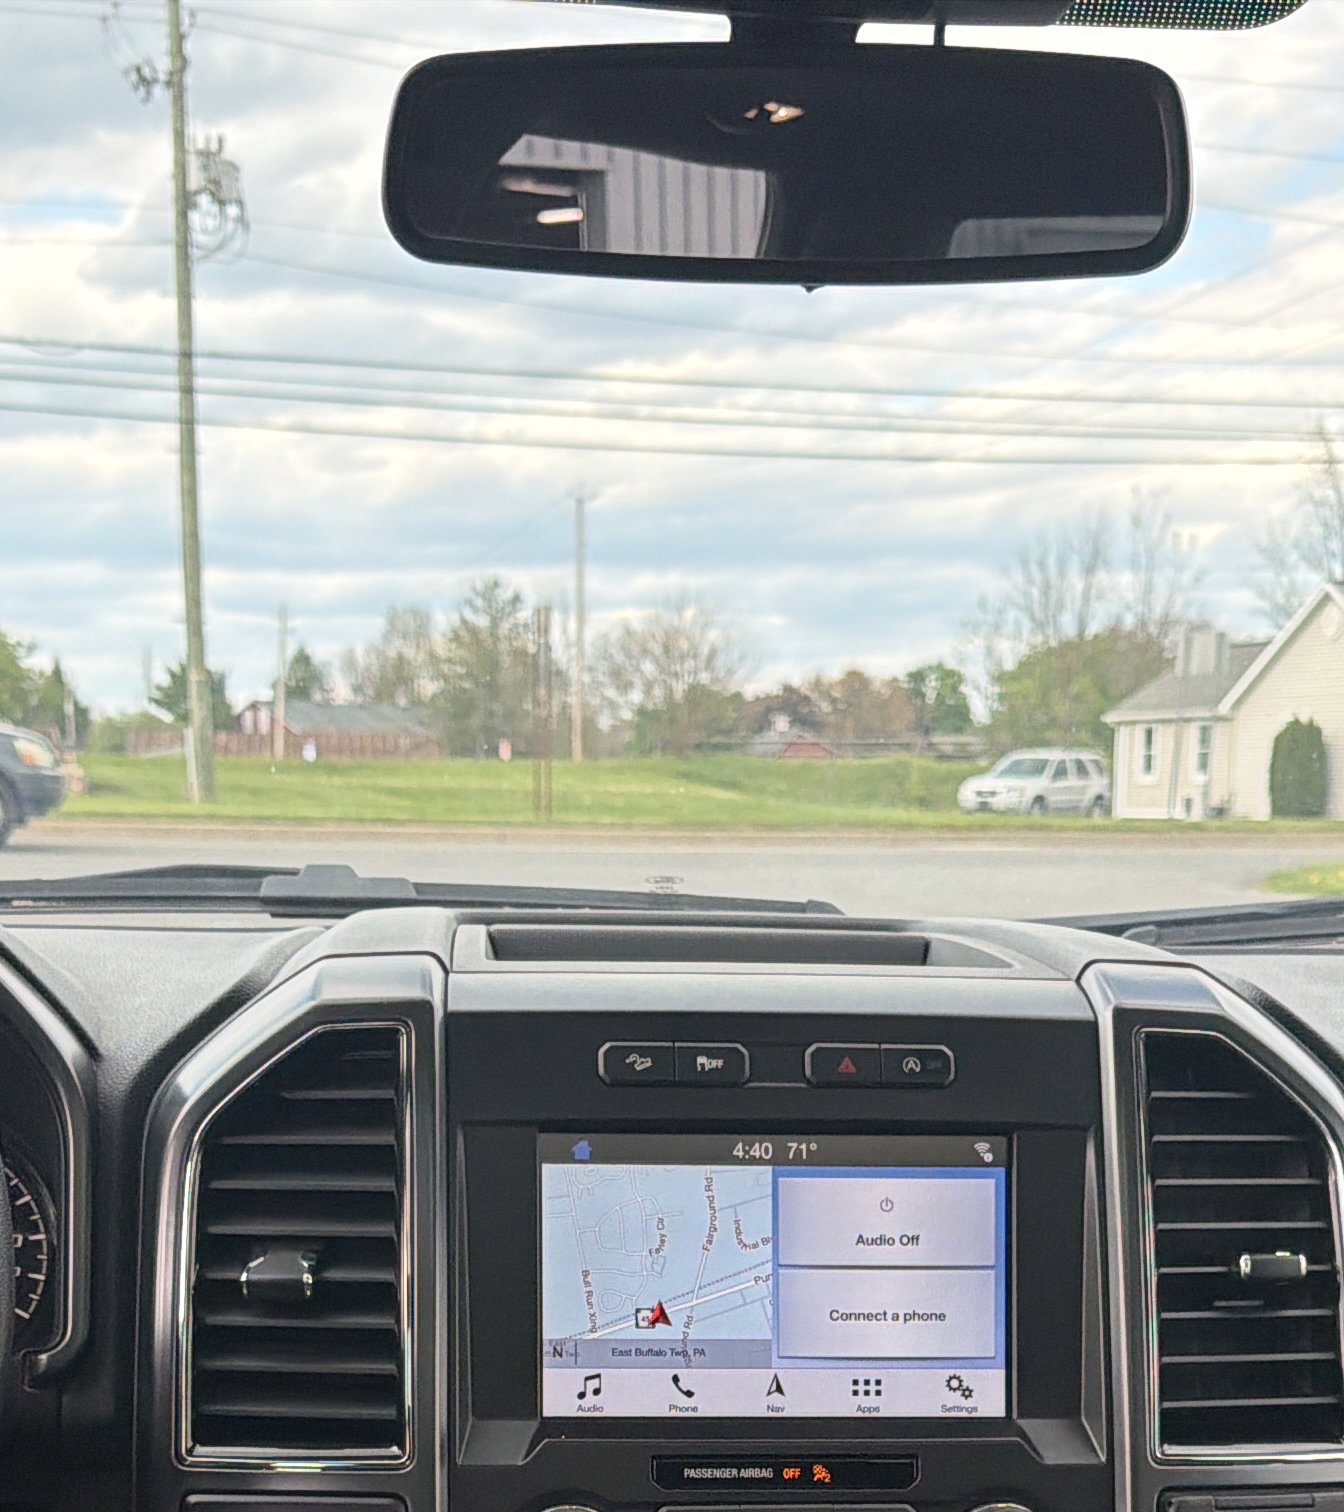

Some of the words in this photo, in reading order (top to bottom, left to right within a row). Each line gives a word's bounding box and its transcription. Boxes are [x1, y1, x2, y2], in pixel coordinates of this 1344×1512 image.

[707, 1058, 724, 1070] OFF
[732, 1142, 773, 1160] 4:40
[786, 1142, 818, 1160] 71°
[704, 1176, 714, 1193] Rd
[702, 1195, 718, 1252] Fairground
[855, 1234, 895, 1247] Audio
[899, 1234, 920, 1247] Off
[582, 1269, 592, 1288] Bull
[584, 1290, 594, 1309] Run
[588, 1312, 599, 1334] Xing
[829, 1309, 887, 1322] Connect
[891, 1312, 899, 1322] a
[903, 1309, 946, 1324] phone
[552, 1344, 563, 1358] N
[611, 1348, 632, 1357] East
[635, 1347, 667, 1357] Buffalo
[693, 1347, 706, 1357] PA
[576, 1403, 604, 1413] Audio
[668, 1403, 699, 1413] Phone
[766, 1404, 785, 1413] Nav
[856, 1404, 880, 1415] Apps
[940, 1404, 978, 1415] Settings
[684, 1468, 738, 1479] PASSENGER
[739, 1468, 774, 1479] AIRBAG
[783, 1468, 801, 1479] OFF
